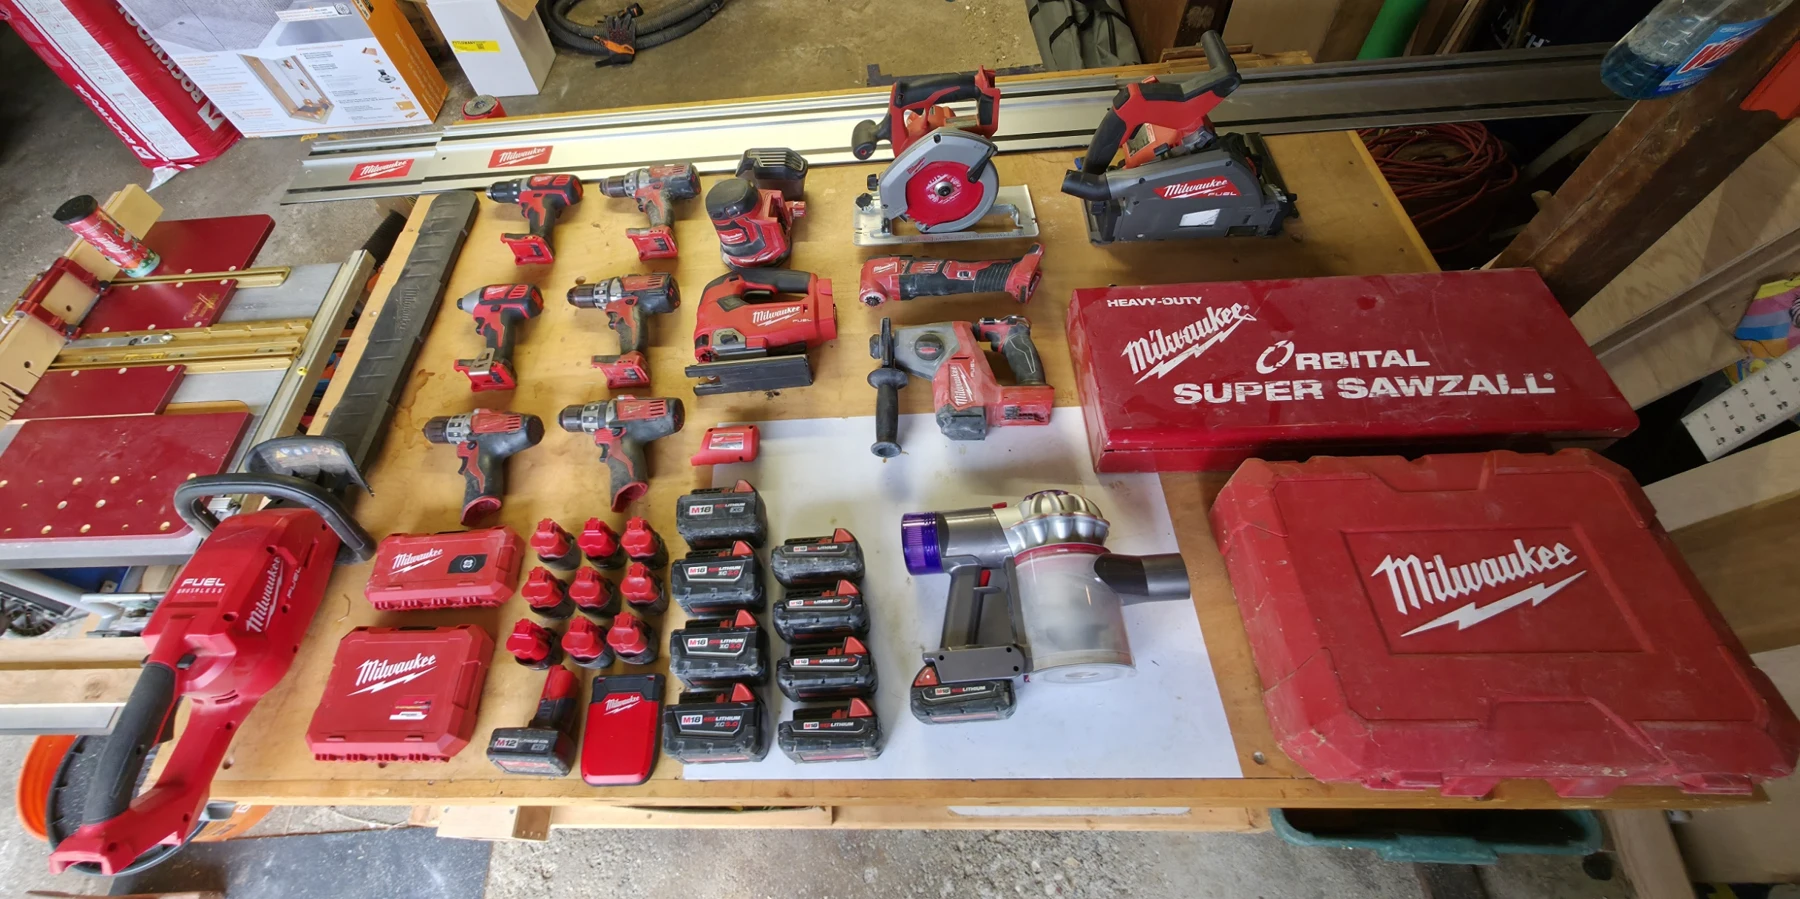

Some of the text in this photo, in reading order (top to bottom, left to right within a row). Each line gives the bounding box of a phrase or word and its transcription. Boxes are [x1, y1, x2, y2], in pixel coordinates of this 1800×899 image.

[499, 147, 546, 163] Milwaukee
[360, 160, 408, 175] Milwaukee
[1163, 179, 1228, 198] Milwaukee
[1106, 296, 1202, 308] HEAVY-DUTY
[752, 305, 801, 323] Milwaukee
[1120, 302, 1246, 375] Milwaukee
[1255, 339, 1431, 375] ORBITAL
[951, 365, 968, 407] Milwaukee
[1173, 372, 1556, 405] SUPER SAWZALL
[690, 505, 712, 515] M18
[391, 548, 443, 570] Milwaukee
[181, 577, 226, 587] FUEL
[1371, 538, 1578, 616] Milwaukee
[245, 557, 280, 633] Milwaukee
[688, 638, 707, 646] M18
[355, 653, 437, 687] Milwaukee
[605, 694, 640, 711] Milwaukee
[682, 715, 702, 724] M18
[495, 738, 517, 748] M12
